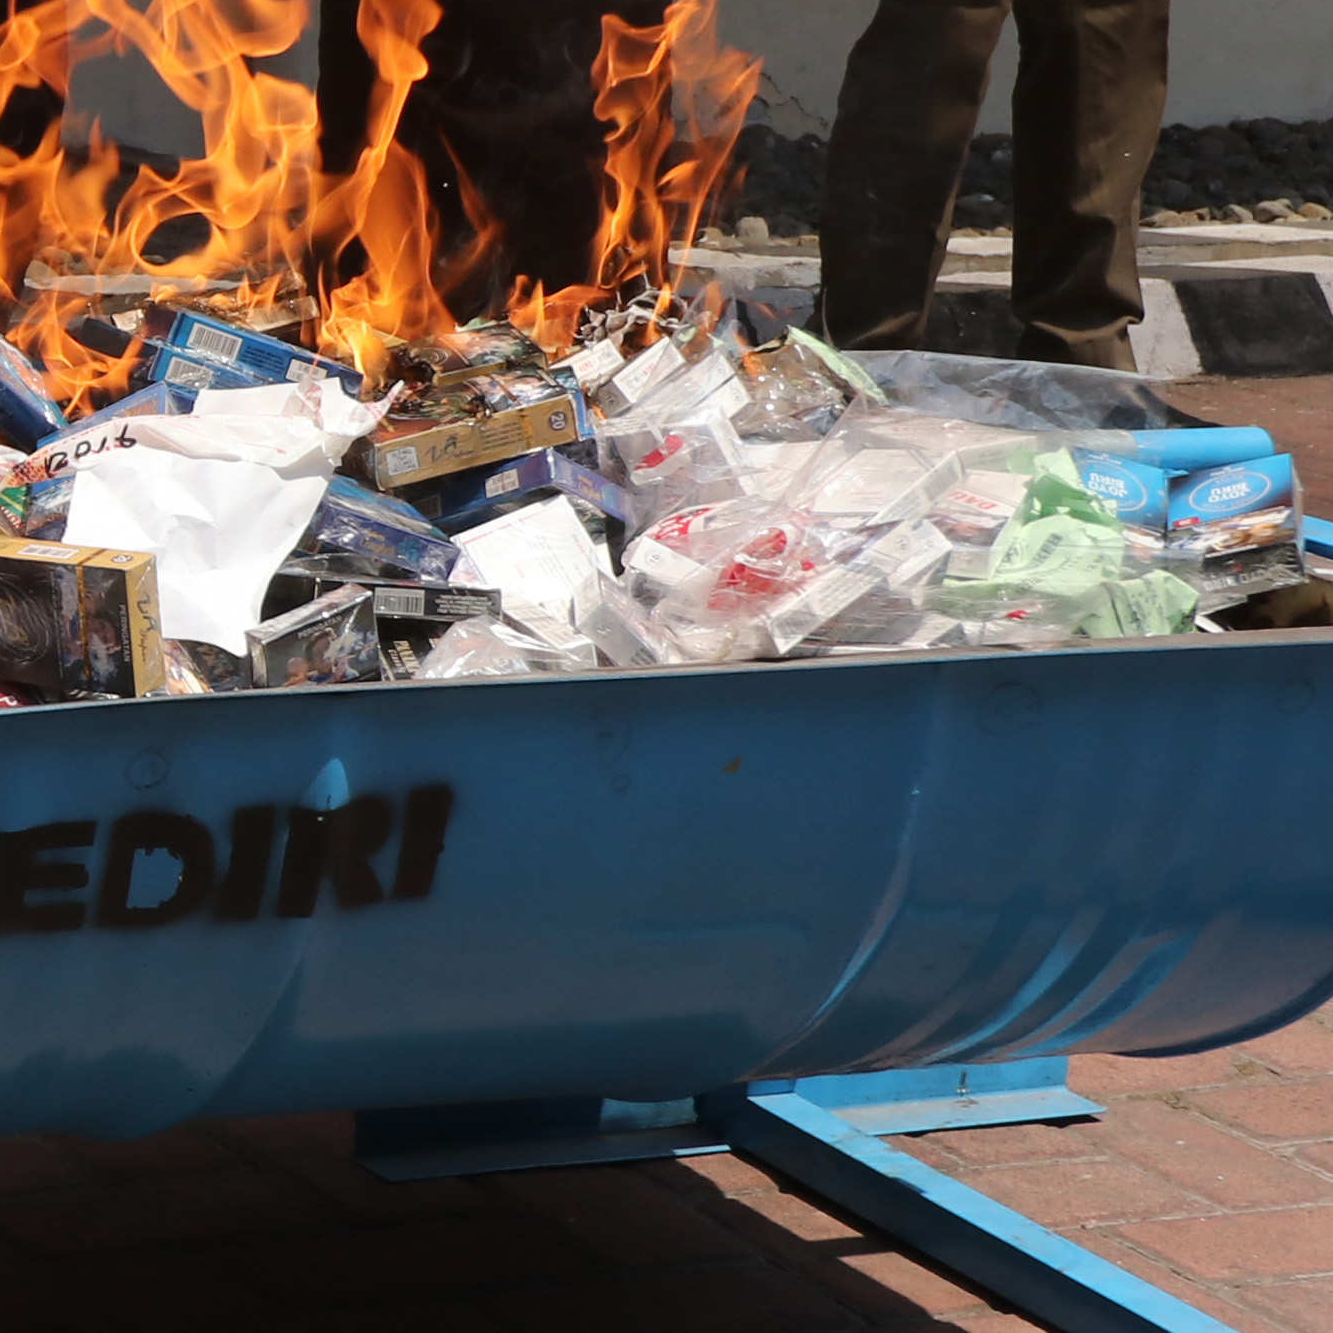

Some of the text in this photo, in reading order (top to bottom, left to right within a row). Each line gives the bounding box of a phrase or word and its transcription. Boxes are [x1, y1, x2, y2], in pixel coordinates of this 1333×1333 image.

[550, 411, 565, 431] 20
[1208, 487, 1251, 503] JOYO
[1210, 481, 1249, 496] BIRU
[950, 489, 997, 511] DAU
[118, 603, 131, 663] PERINGATAN
